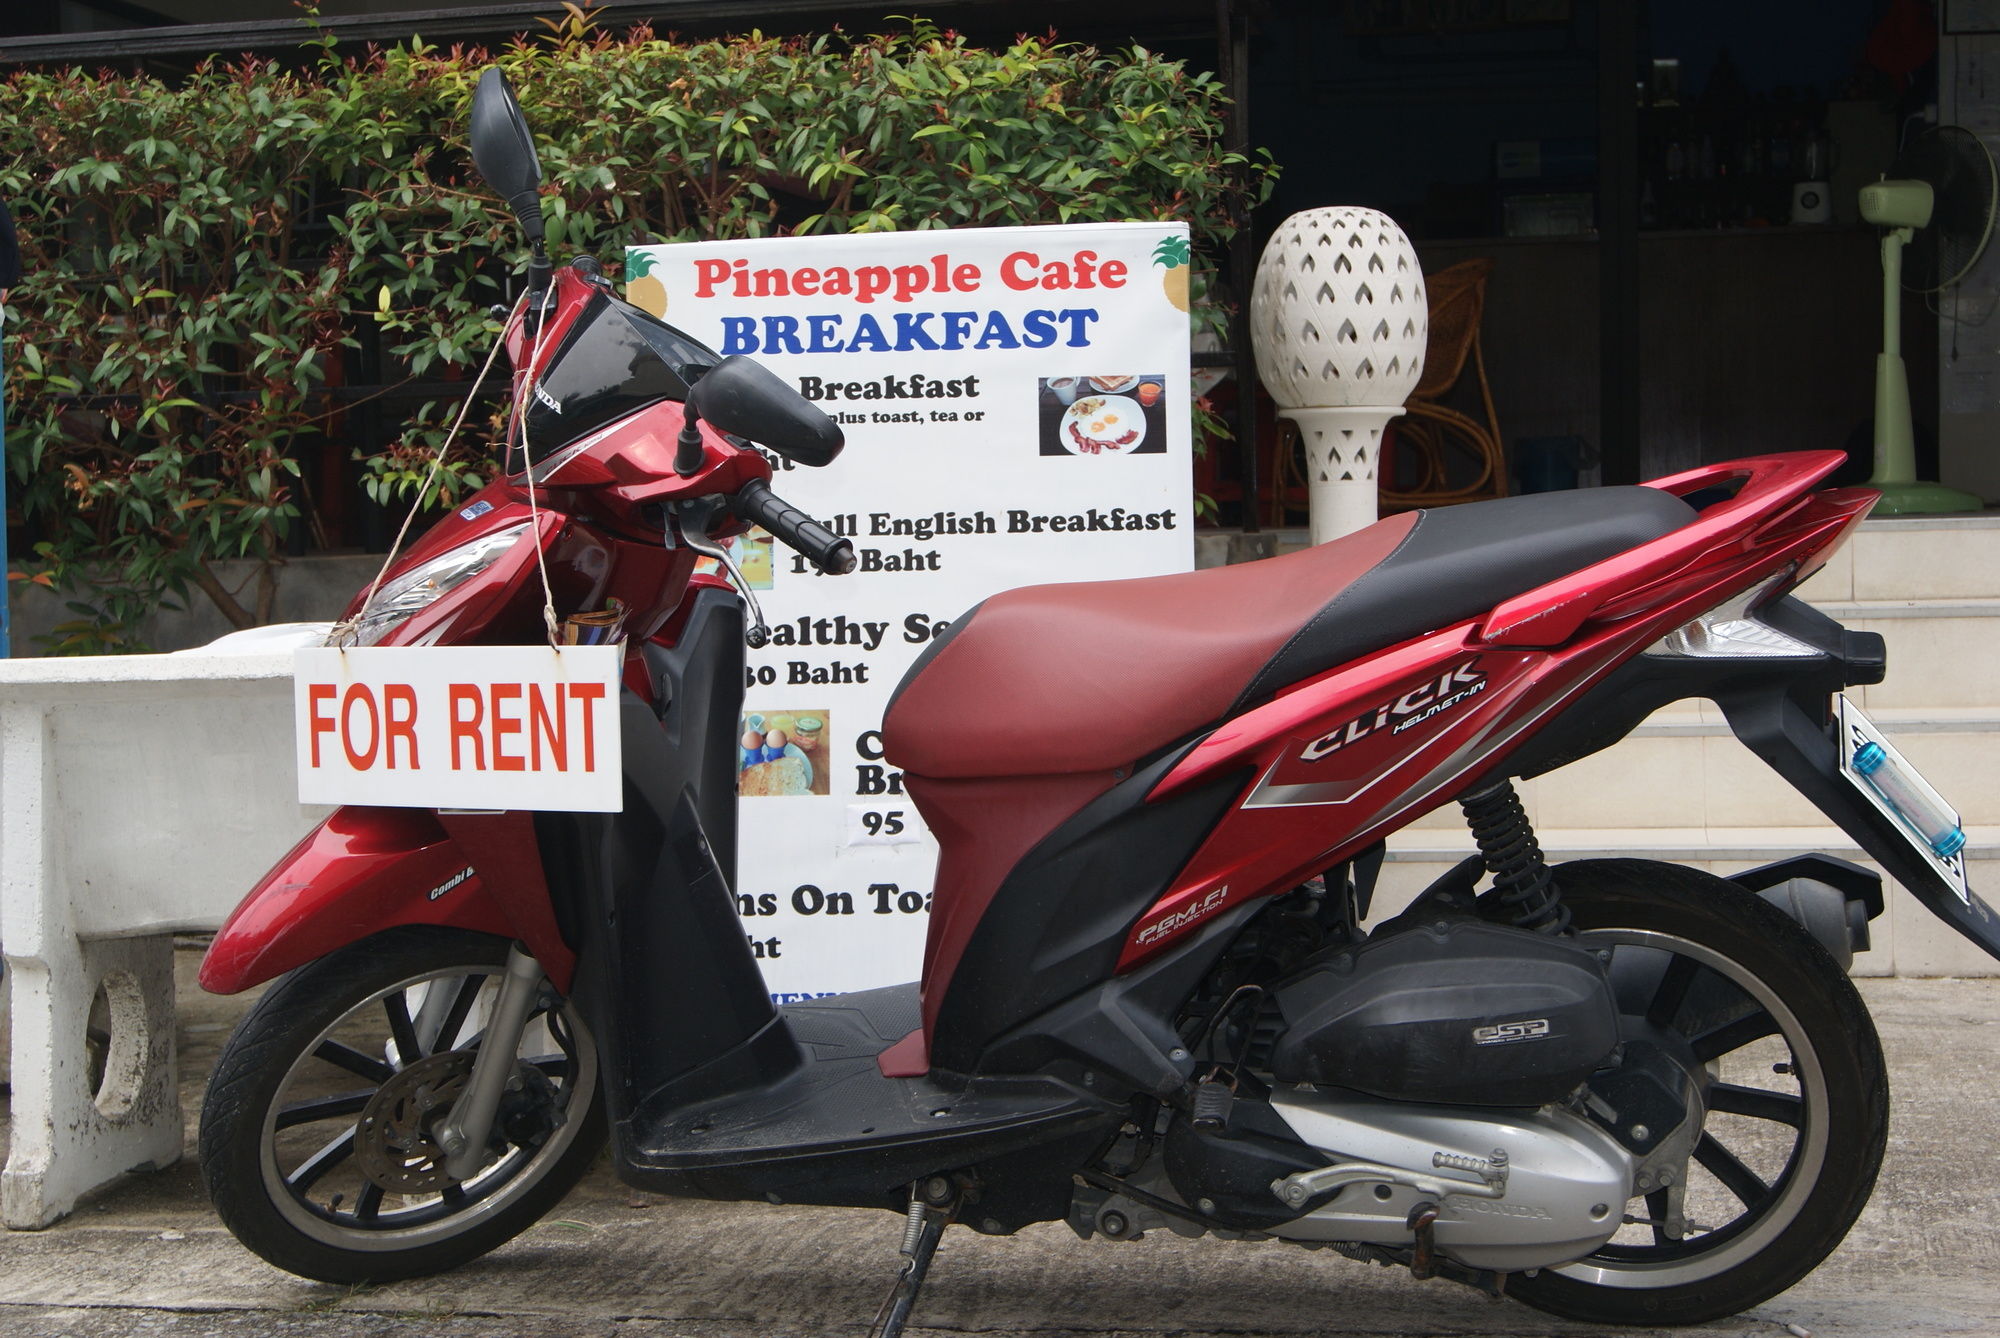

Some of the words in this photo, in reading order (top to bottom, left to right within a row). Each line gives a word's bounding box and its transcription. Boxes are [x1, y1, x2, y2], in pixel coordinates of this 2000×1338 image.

[693, 254, 981, 304] Pineapple
[999, 250, 1128, 291] Cafe
[719, 308, 1099, 356] BREAKFAST
[799, 373, 980, 400] Breakfast
[871, 410, 925, 425] toast,
[929, 410, 959, 423] tea
[963, 411, 985, 422] or
[868, 511, 997, 541] English
[1006, 507, 1177, 534] Breakfast
[859, 548, 942, 573] Baht
[786, 660, 870, 685] Baht
[308, 683, 420, 772] FOR
[448, 683, 606, 773] RENT
[862, 811, 905, 837] 95
[430, 870, 465, 900] Combi
[791, 884, 855, 916] On
[1139, 885, 1228, 942] PGM-FI
